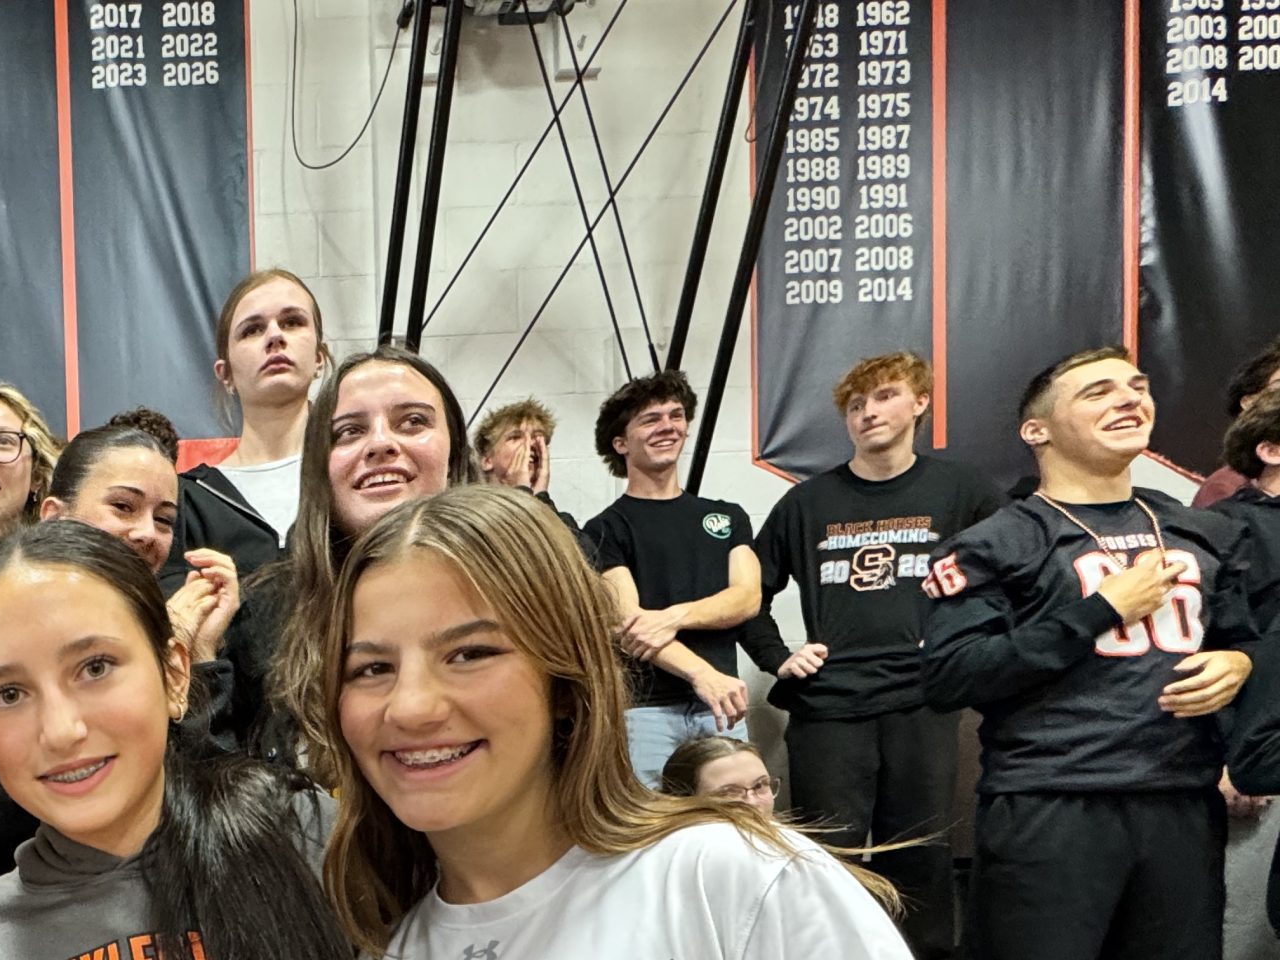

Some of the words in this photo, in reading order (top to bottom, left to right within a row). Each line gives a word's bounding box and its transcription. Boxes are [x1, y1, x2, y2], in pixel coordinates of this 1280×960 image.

[90, 4, 142, 29] 2017
[162, 2, 215, 27] 2018
[856, 1, 910, 27] 1962
[859, 30, 908, 56] 1971
[1166, 15, 1227, 43] 2003
[1238, 15, 1280, 41] 200
[91, 35, 145, 61] 2021
[161, 33, 217, 58] 2022
[1166, 44, 1228, 74] 2008
[1238, 44, 1280, 71] 200
[91, 62, 147, 89] 2023
[163, 60, 219, 87] 2026
[797, 63, 839, 88] 972
[857, 59, 911, 86] 1973
[1167, 77, 1228, 107] 2014
[789, 95, 840, 122] 974
[857, 92, 911, 119] 1975
[786, 127, 840, 154] 1985
[857, 124, 911, 150] 1987
[786, 156, 840, 183] 1988
[857, 153, 910, 180] 1989
[786, 186, 840, 212] 1990
[859, 183, 908, 210] 1991
[784, 215, 842, 242] 2002
[854, 213, 913, 240] 2006
[784, 248, 842, 274] 2007
[855, 245, 914, 272] 2008
[786, 279, 843, 305] 2009
[858, 276, 913, 303] 2014
[826, 521, 873, 537] BLACK
[875, 516, 931, 533] HORSES
[827, 527, 930, 550] HOMECOMING
[820, 560, 850, 585] 20
[897, 553, 930, 578] 26
